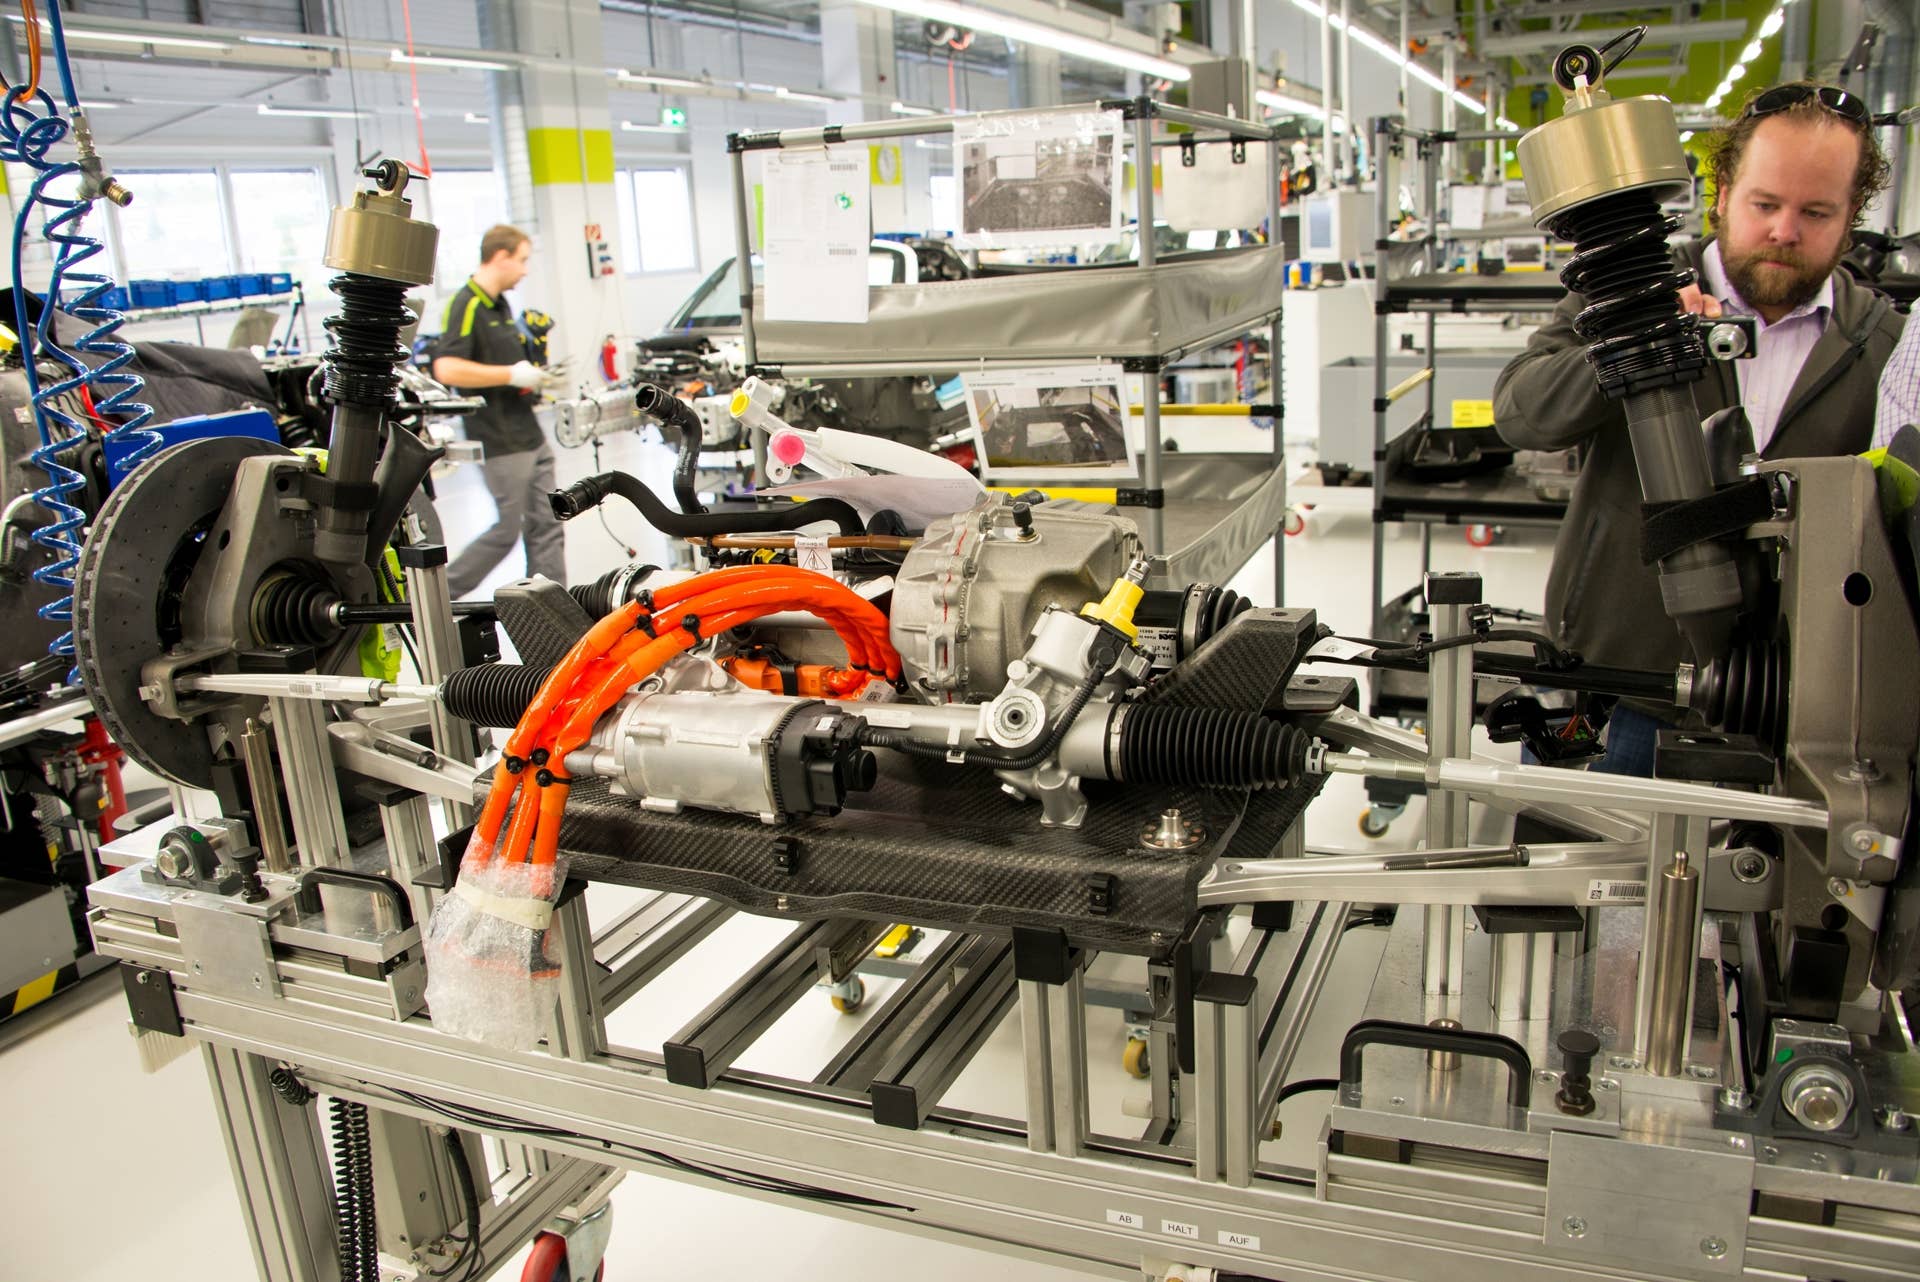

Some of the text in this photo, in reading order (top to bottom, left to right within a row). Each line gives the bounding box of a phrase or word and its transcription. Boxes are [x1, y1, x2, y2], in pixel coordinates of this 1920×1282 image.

[1118, 1214, 1132, 1224] AB
[1167, 1223, 1193, 1236] HALT
[1228, 1235, 1250, 1246] AUF
